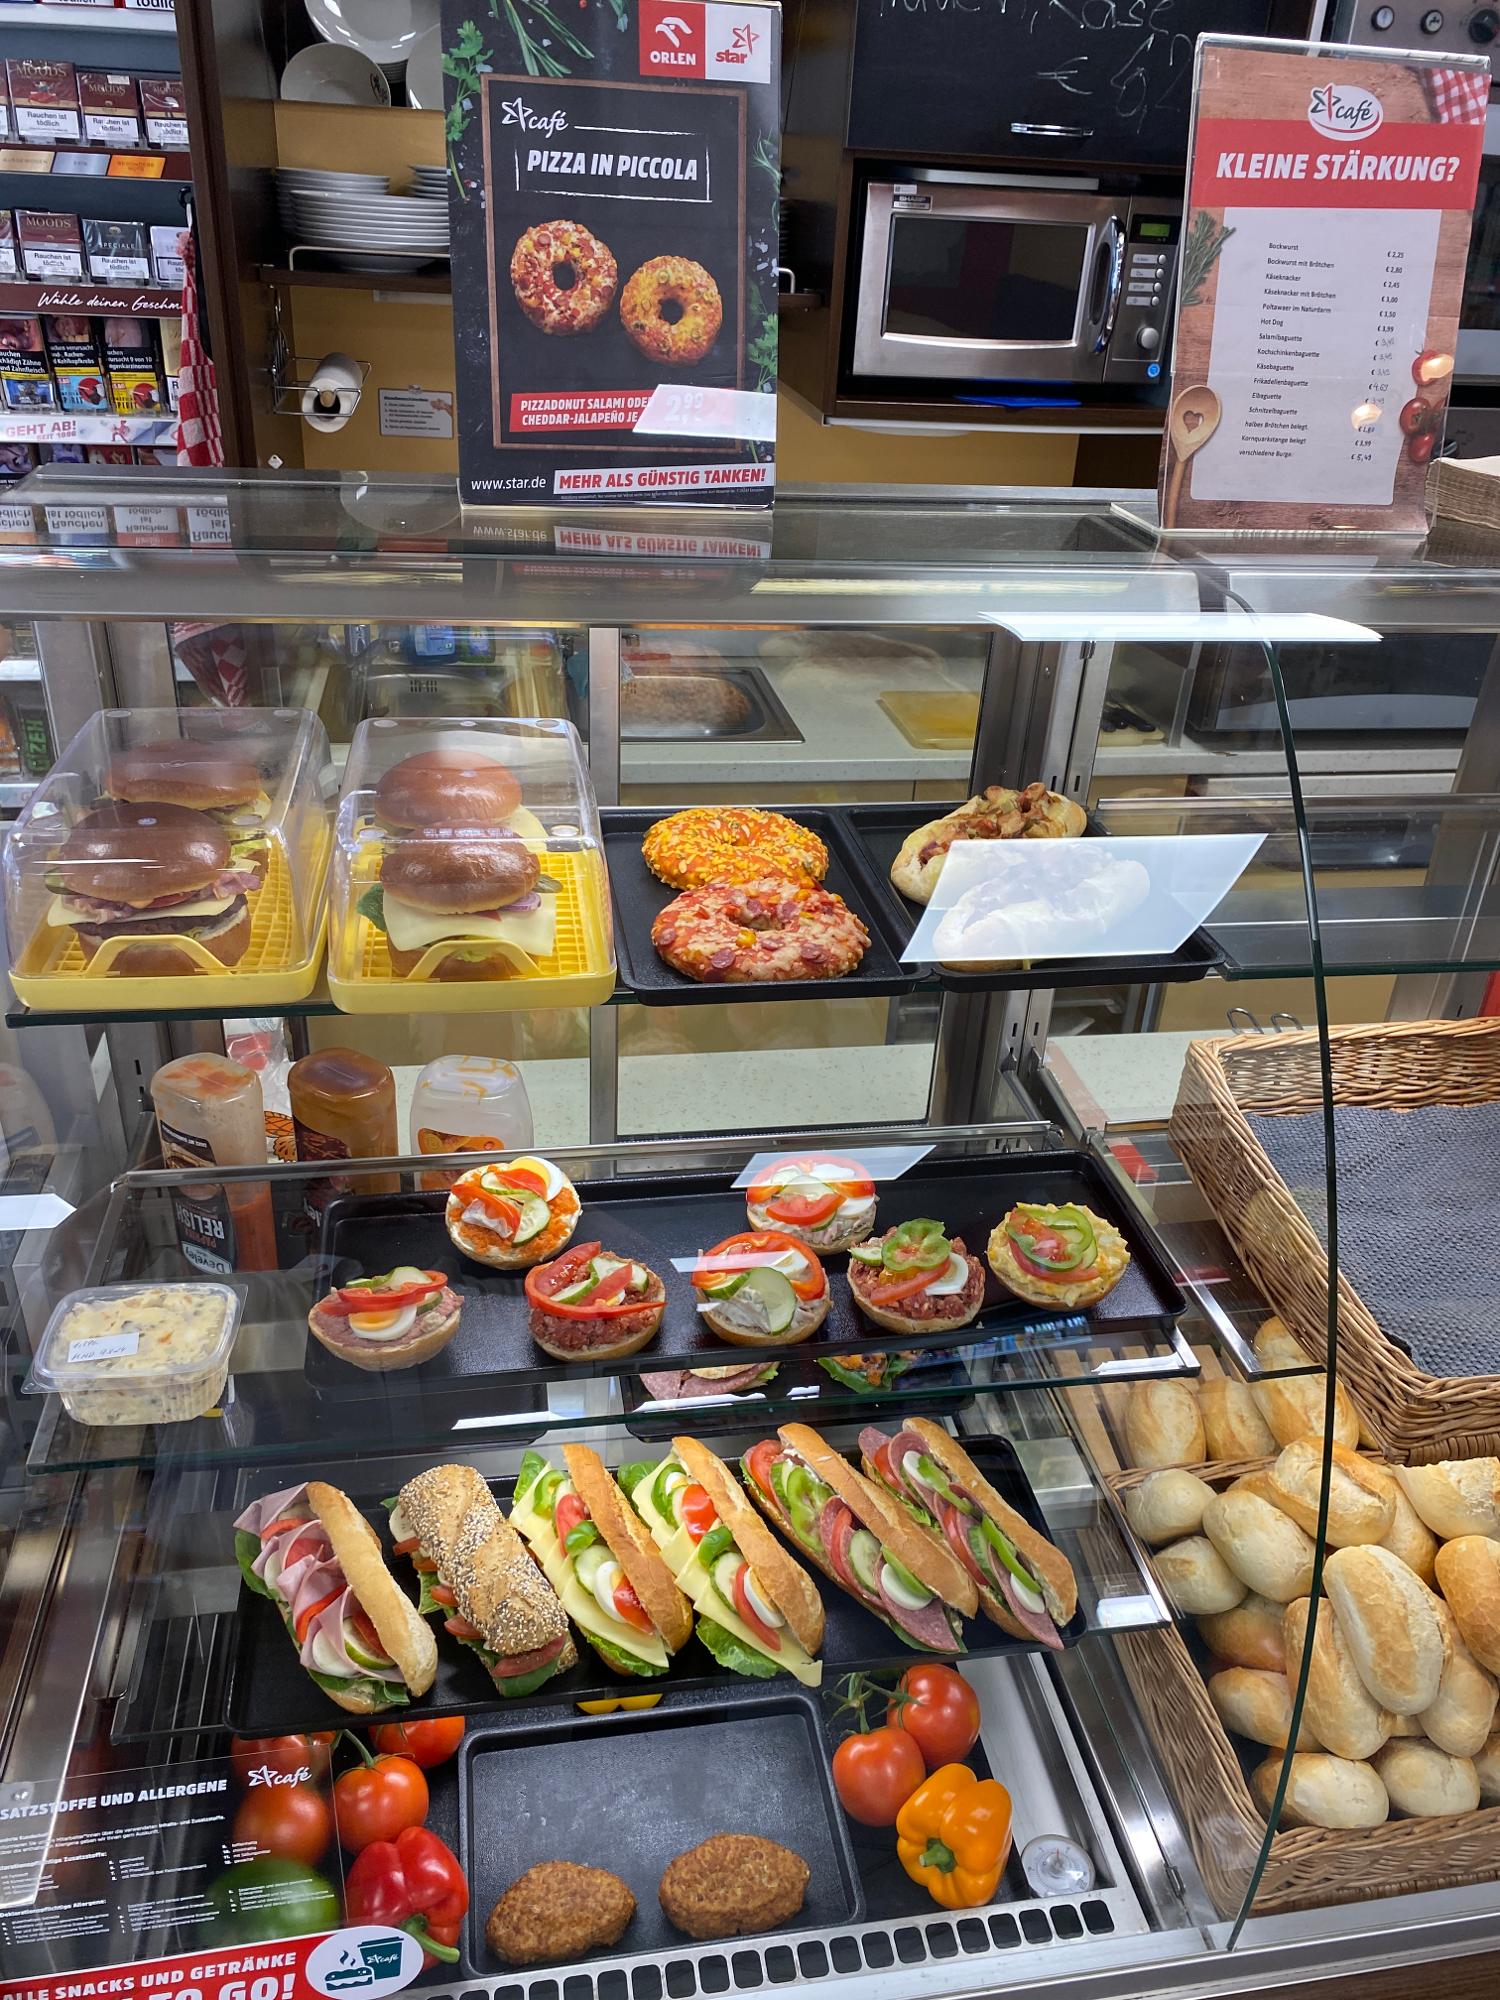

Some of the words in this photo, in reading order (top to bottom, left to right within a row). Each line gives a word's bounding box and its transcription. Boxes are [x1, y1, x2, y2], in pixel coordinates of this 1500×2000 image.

[650, 51, 697, 66] ORLEN
[715, 49, 748, 64] star
[1335, 101, 1375, 129] café
[528, 110, 569, 139] café
[526, 149, 586, 175] PIZZA
[591, 154, 613, 177] IN
[616, 155, 698, 181] PICCOLA
[1216, 152, 1307, 180] KLEINE
[1312, 150, 1461, 183] STÄRKUNG?
[26, 217, 72, 228] MOODS
[1269, 242, 1299, 251] Bockwurst
[34, 252, 61, 261] Rauchen
[61, 253, 72, 261] ist
[101, 257, 128, 265] Rauchen
[1267, 257, 1297, 266] Bockwurst
[38, 291, 84, 308] Wähle
[86, 293, 129, 308] deinen
[1272, 318, 1284, 328] Dog
[1259, 332, 1303, 342] Salamibaguette
[1256, 363, 1295, 372] Käsebaguette
[520, 398, 585, 412] PIZZADONUT
[587, 397, 625, 410] SALAMI
[1249, 406, 1298, 416] Schnitzelbaguette
[522, 410, 625, 426] CHEDDAR-JALAPEÑO
[626, 411, 639, 423] JE
[6, 423, 47, 437] GEHT
[52, 420, 77, 431] AB!
[1239, 449, 1275, 457] verschiedene
[471, 476, 547, 492] www.star.de
[559, 474, 603, 489] MEHR
[605, 473, 634, 488] ALS
[637, 470, 700, 487] GÜNSTIG
[704, 468, 767, 485] TANKEN!
[176, 1201, 225, 1240] RELISH
[272, 1766, 313, 1788] café
[0, 1796, 97, 1821] SATZSTOFFE
[100, 1792, 135, 1807] UND
[137, 1778, 228, 1803] ALLERGENE
[55, 1976, 135, 2000] SNACKS
[140, 1970, 185, 1988] UND
[190, 1951, 297, 1980] GETRÄNKE
